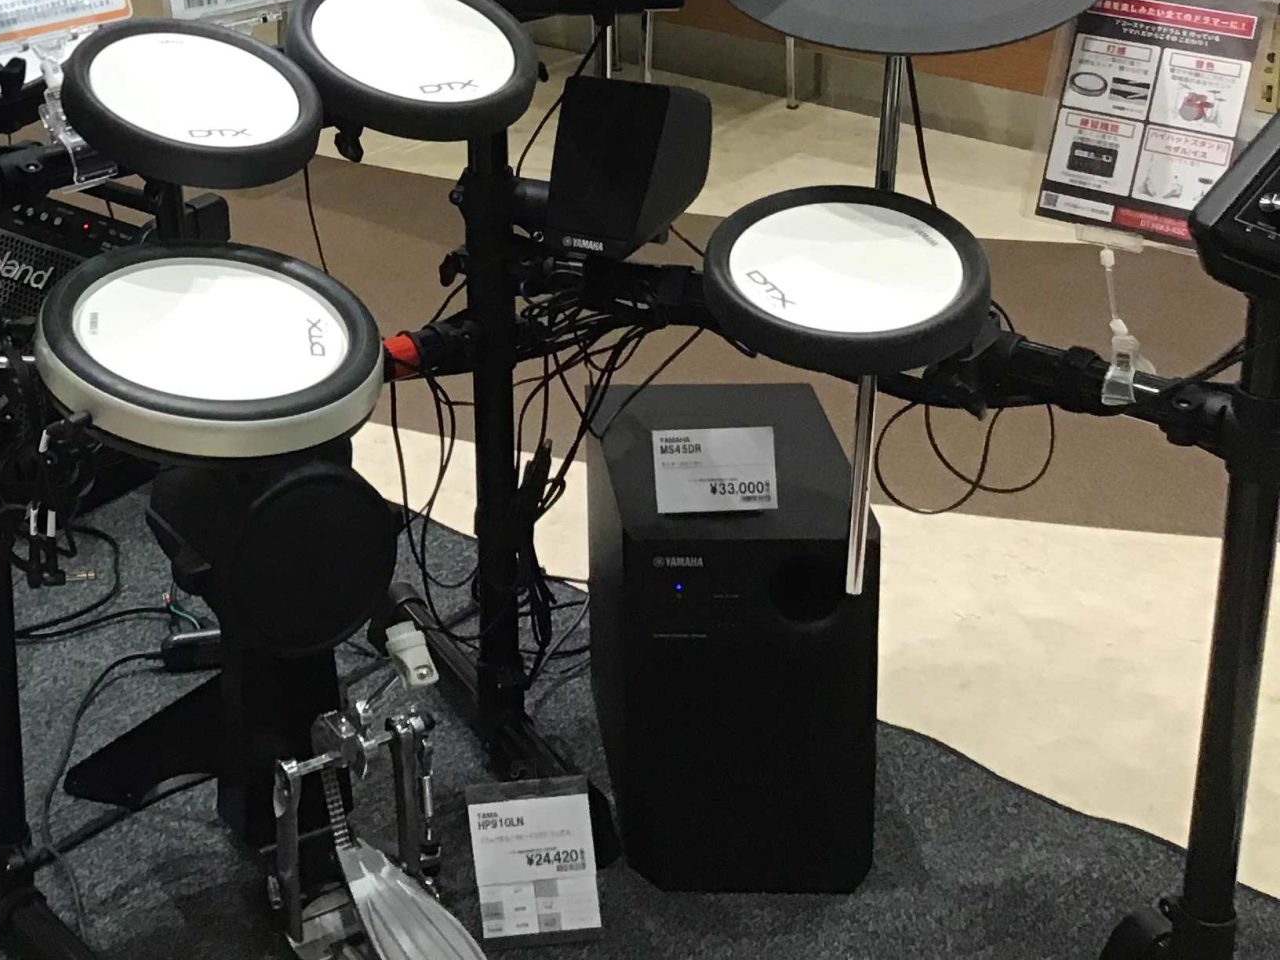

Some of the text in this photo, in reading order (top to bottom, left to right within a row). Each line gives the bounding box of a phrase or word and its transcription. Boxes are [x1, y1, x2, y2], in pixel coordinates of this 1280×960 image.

[419, 79, 479, 95] DTX
[187, 128, 253, 139] DTX
[746, 269, 797, 310] DTX
[306, 318, 326, 357] DTX
[660, 443, 702, 456] MS45DR
[665, 556, 704, 568] YAMAHA
[477, 816, 525, 831] HP910LN
[526, 849, 579, 868] ¥24,420
